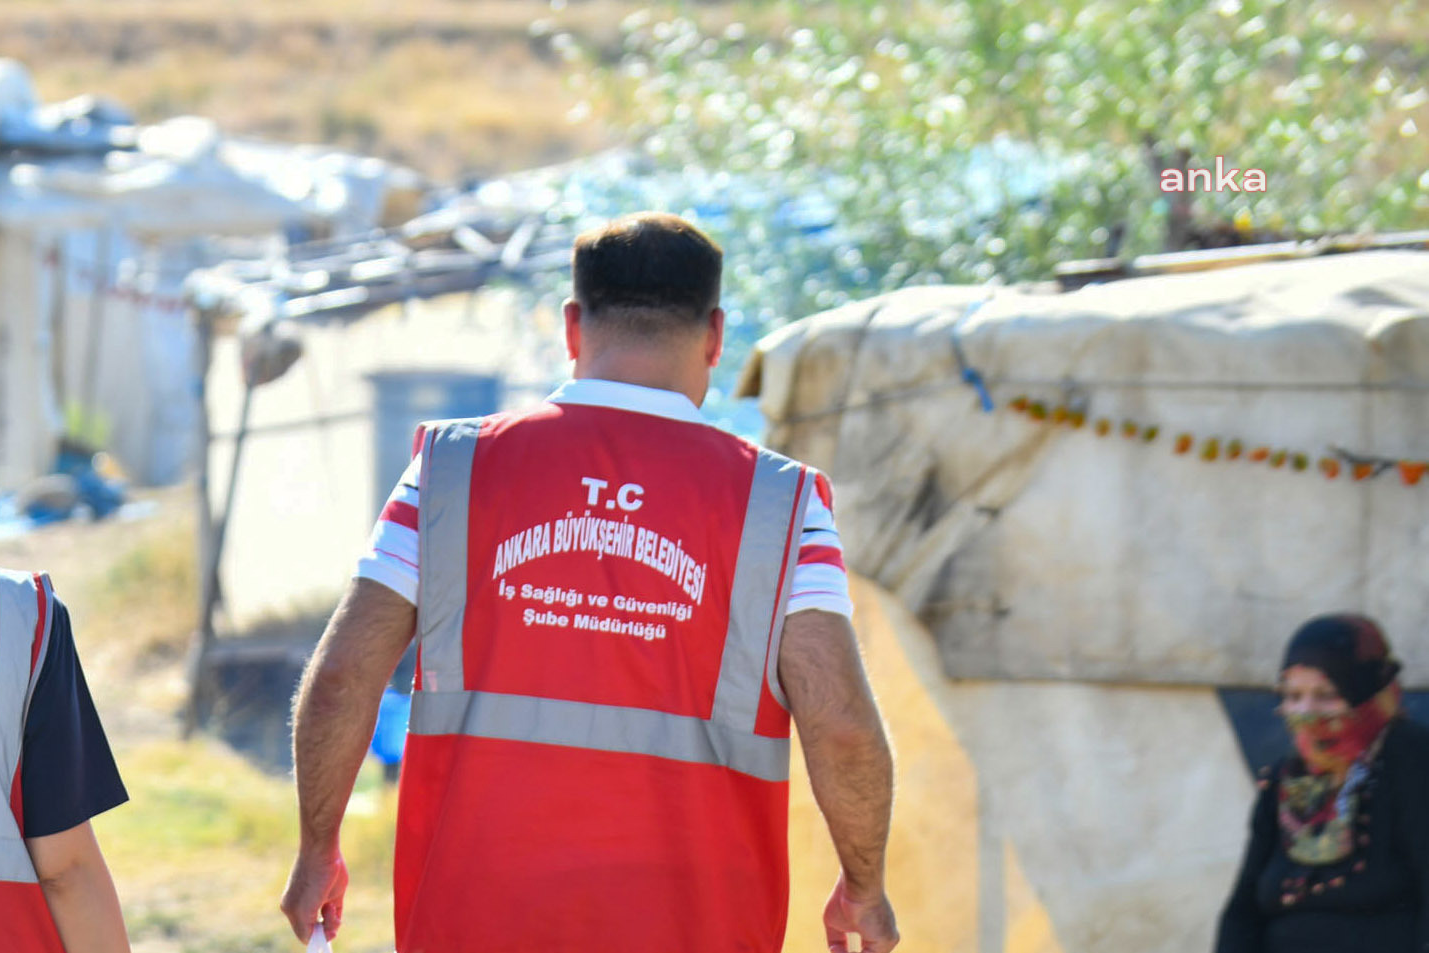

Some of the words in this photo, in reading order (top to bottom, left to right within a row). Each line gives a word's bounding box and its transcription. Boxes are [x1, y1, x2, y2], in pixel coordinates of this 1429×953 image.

[581, 476, 645, 511] T.C
[493, 522, 551, 580] ANKARA
[553, 509, 635, 560] BÜYÜKŞEHİR
[634, 526, 707, 605] BELEDİYESİ
[499, 578, 515, 600] İş
[521, 583, 582, 607] Sağlığı
[588, 593, 607, 607] ve
[613, 595, 692, 621] Güvenliği
[523, 608, 569, 626] Şube
[574, 614, 666, 641] Müdürlüğü
